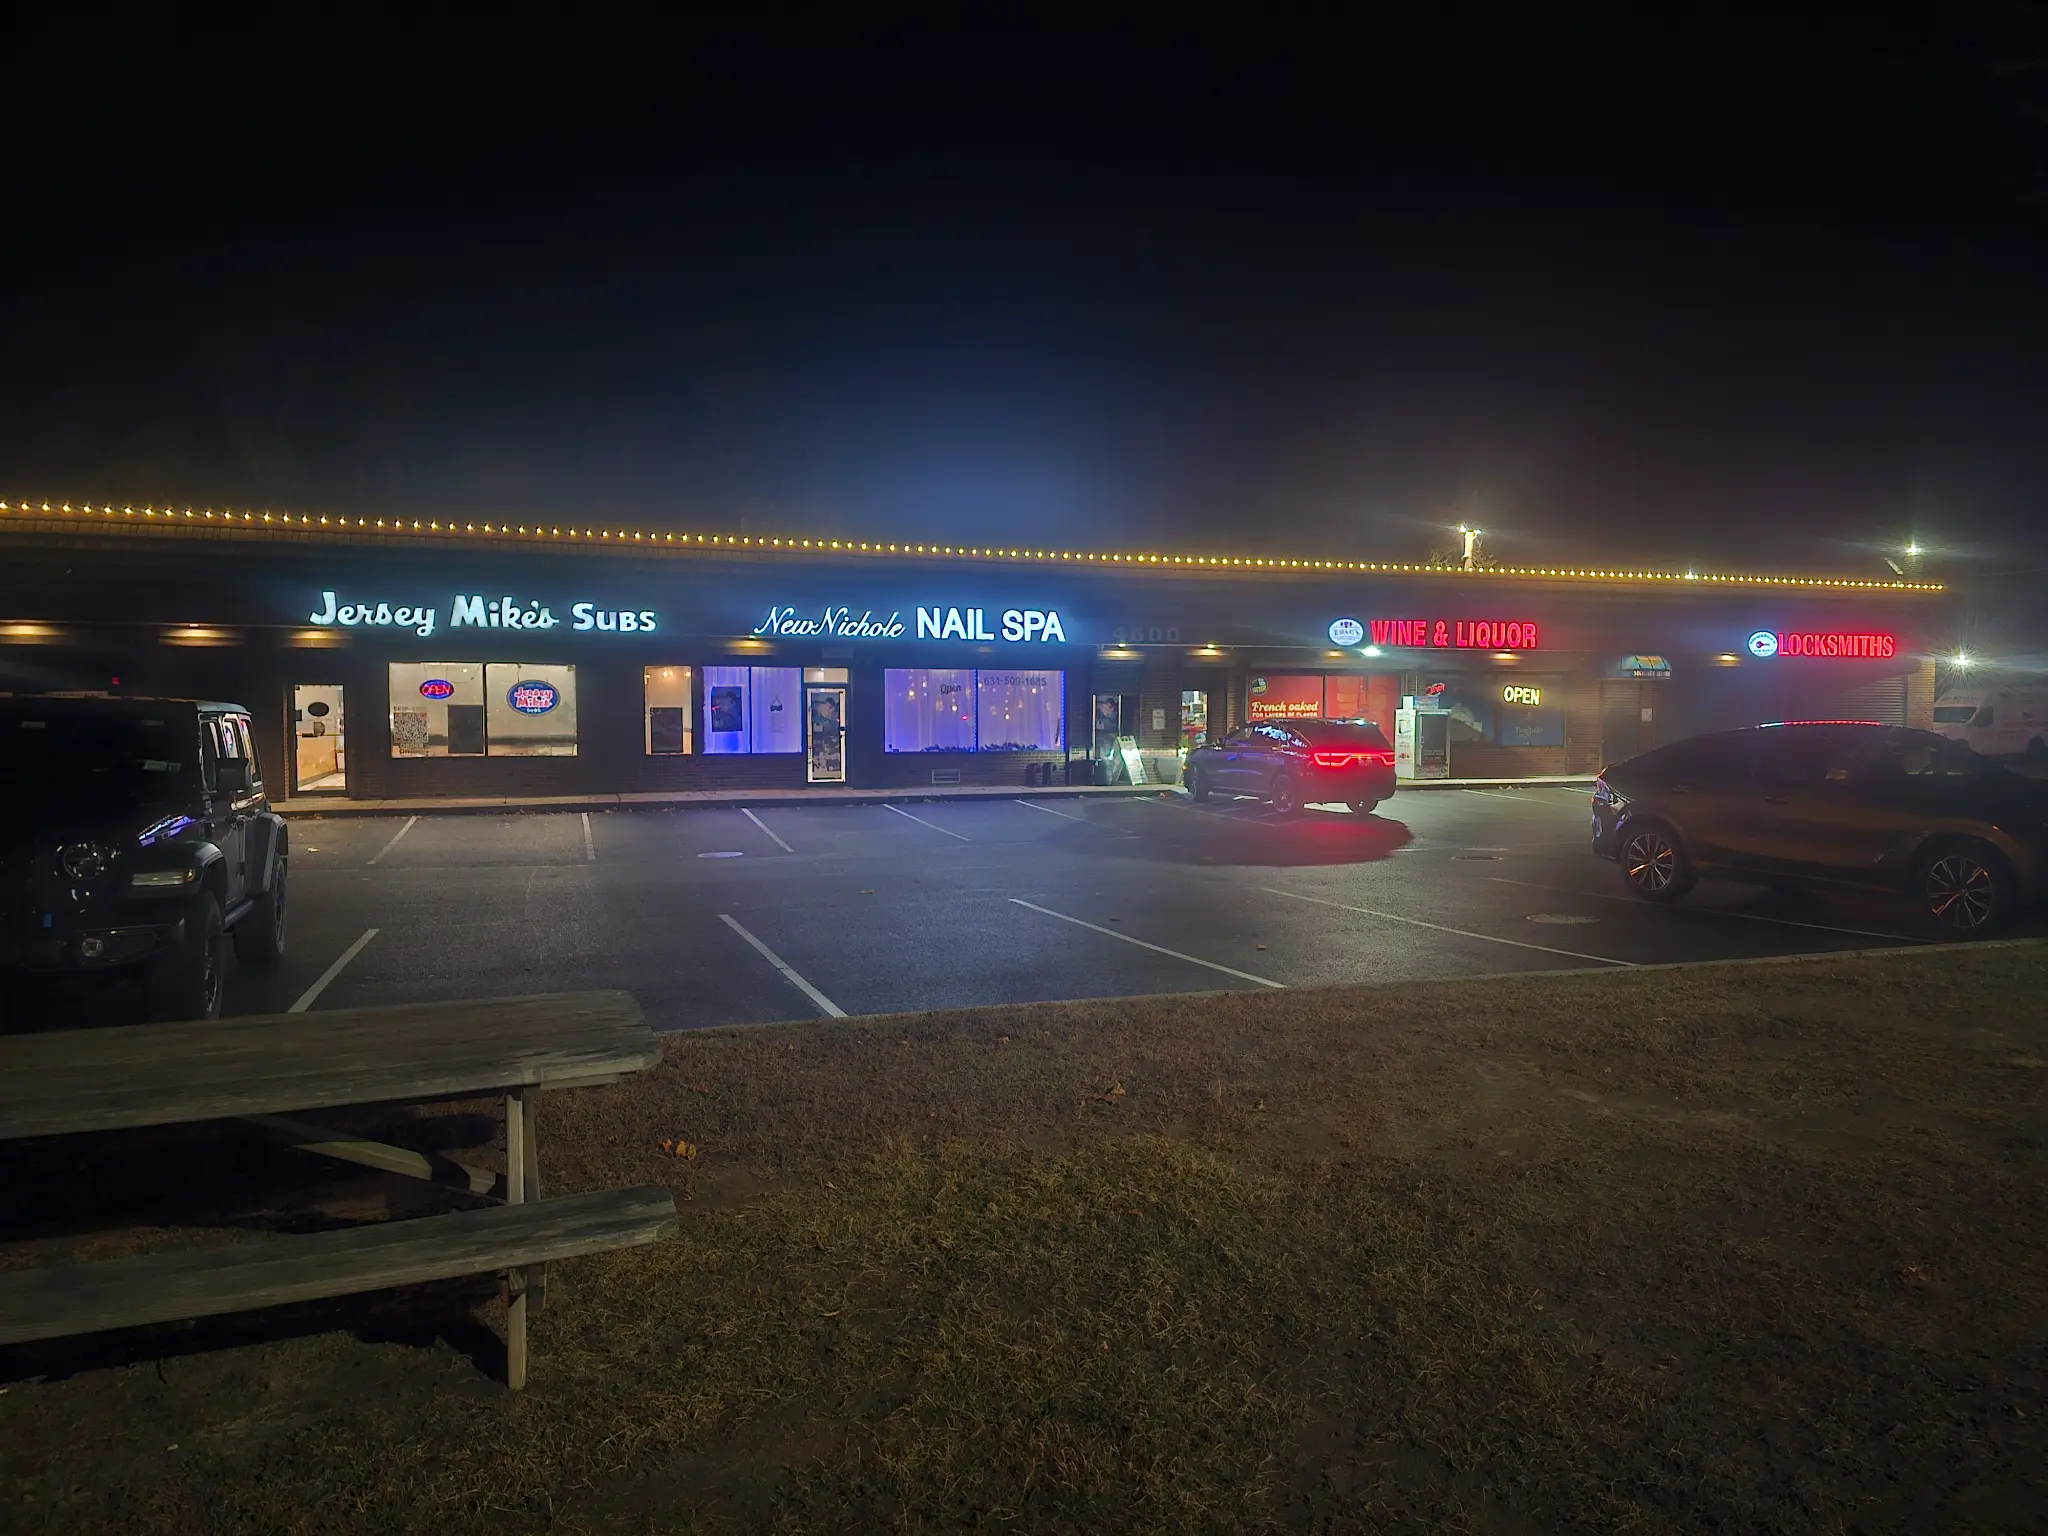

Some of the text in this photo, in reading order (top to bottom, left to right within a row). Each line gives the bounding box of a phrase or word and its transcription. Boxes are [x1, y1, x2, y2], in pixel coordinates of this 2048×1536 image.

[309, 590, 436, 637] Jersey
[450, 595, 560, 630] Mike's
[917, 607, 994, 641] NAIL
[1002, 609, 1066, 643] SPA
[1112, 626, 1179, 642] 4600
[1370, 619, 1537, 648] WINE & LIQUOR
[1777, 632, 1895, 657] LOCKSMITHS
[421, 684, 451, 696] OPEN
[514, 687, 553, 700] Jersey
[940, 684, 961, 695] Open
[1503, 685, 1541, 705] OPEN
[1251, 701, 1319, 712] French oaked
